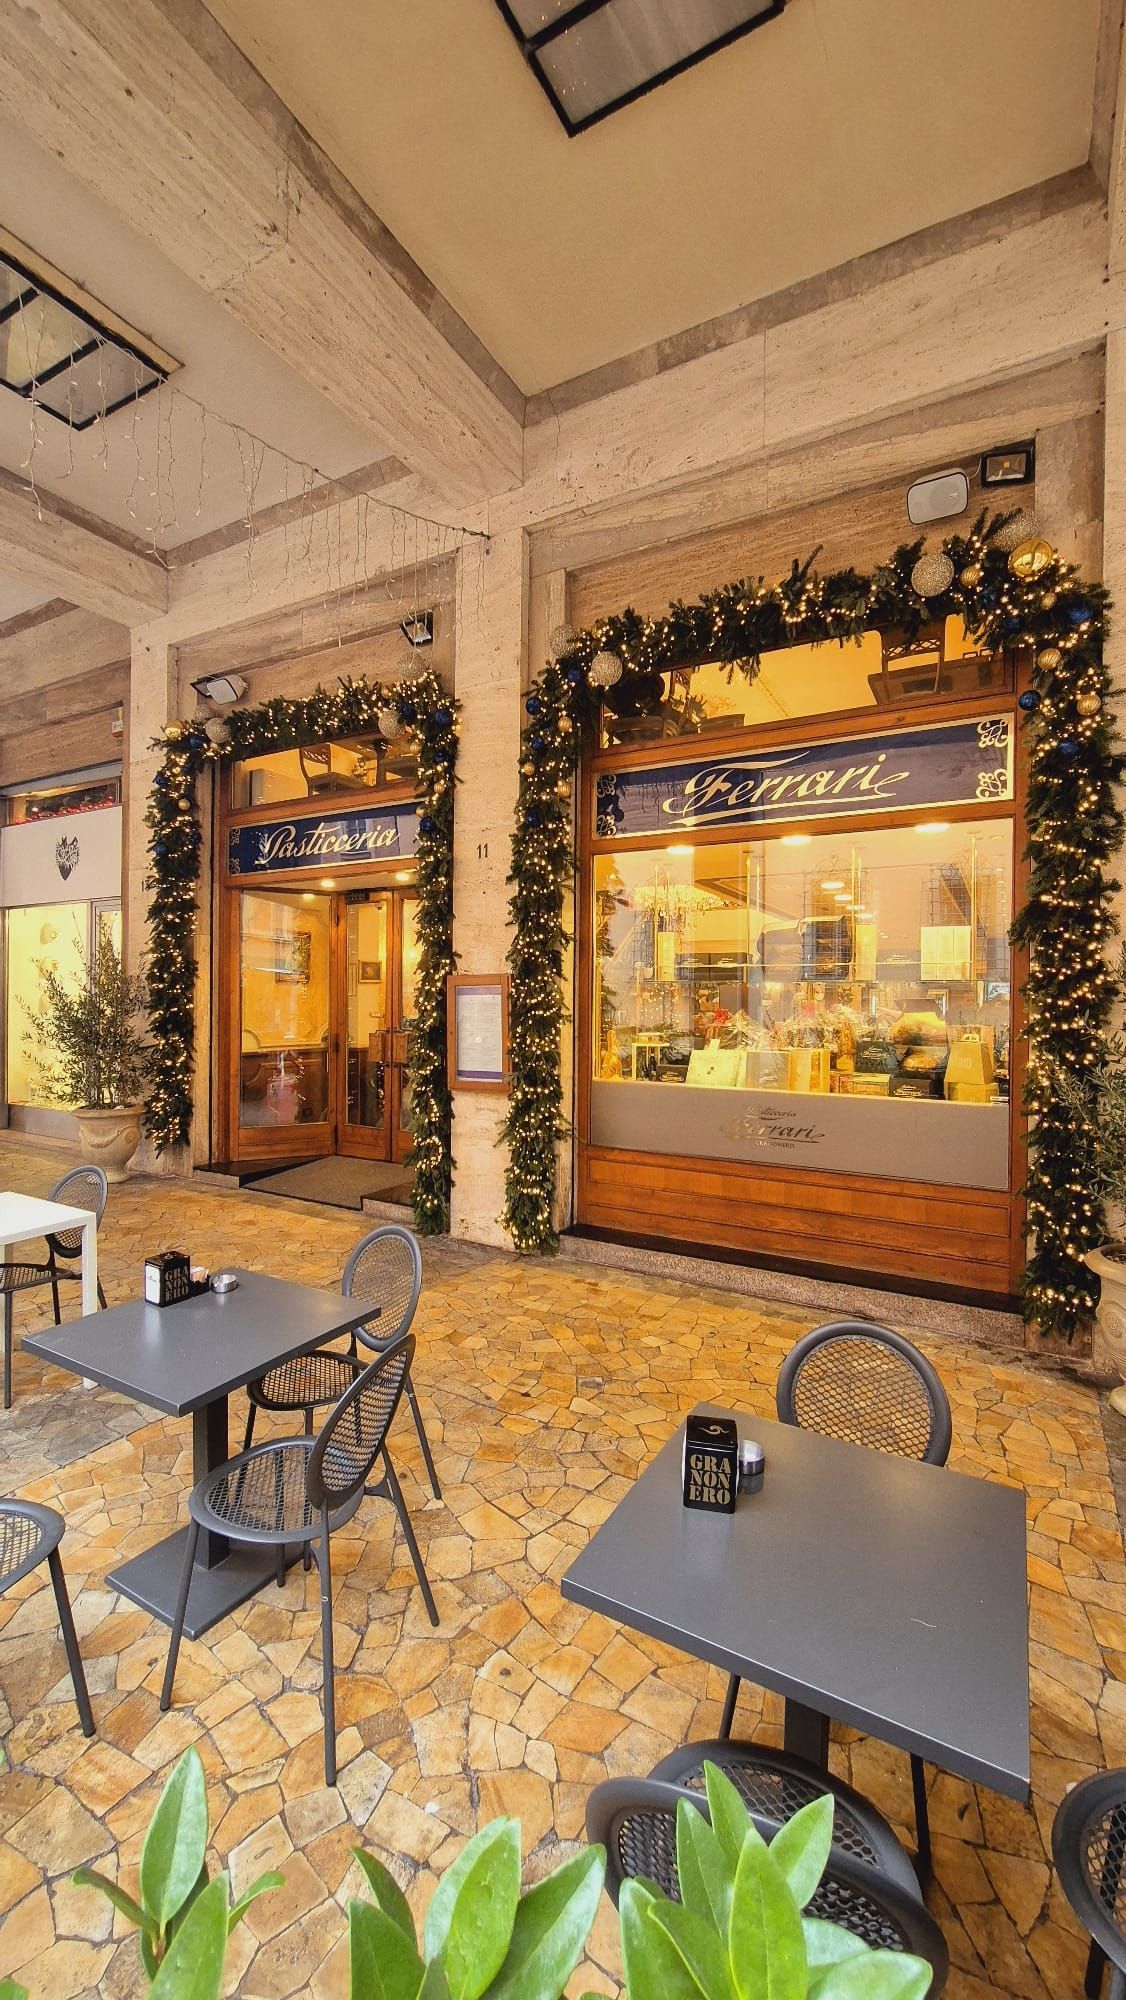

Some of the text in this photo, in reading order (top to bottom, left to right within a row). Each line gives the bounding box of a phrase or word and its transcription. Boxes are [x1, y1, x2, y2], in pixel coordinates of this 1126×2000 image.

[662, 751, 910, 826] Ferrari
[257, 822, 400, 864] Pasticceria
[477, 843, 488, 859] 11
[690, 1454, 732, 1473] GRA
[690, 1469, 731, 1489] NON
[689, 1485, 731, 1504] ERO
